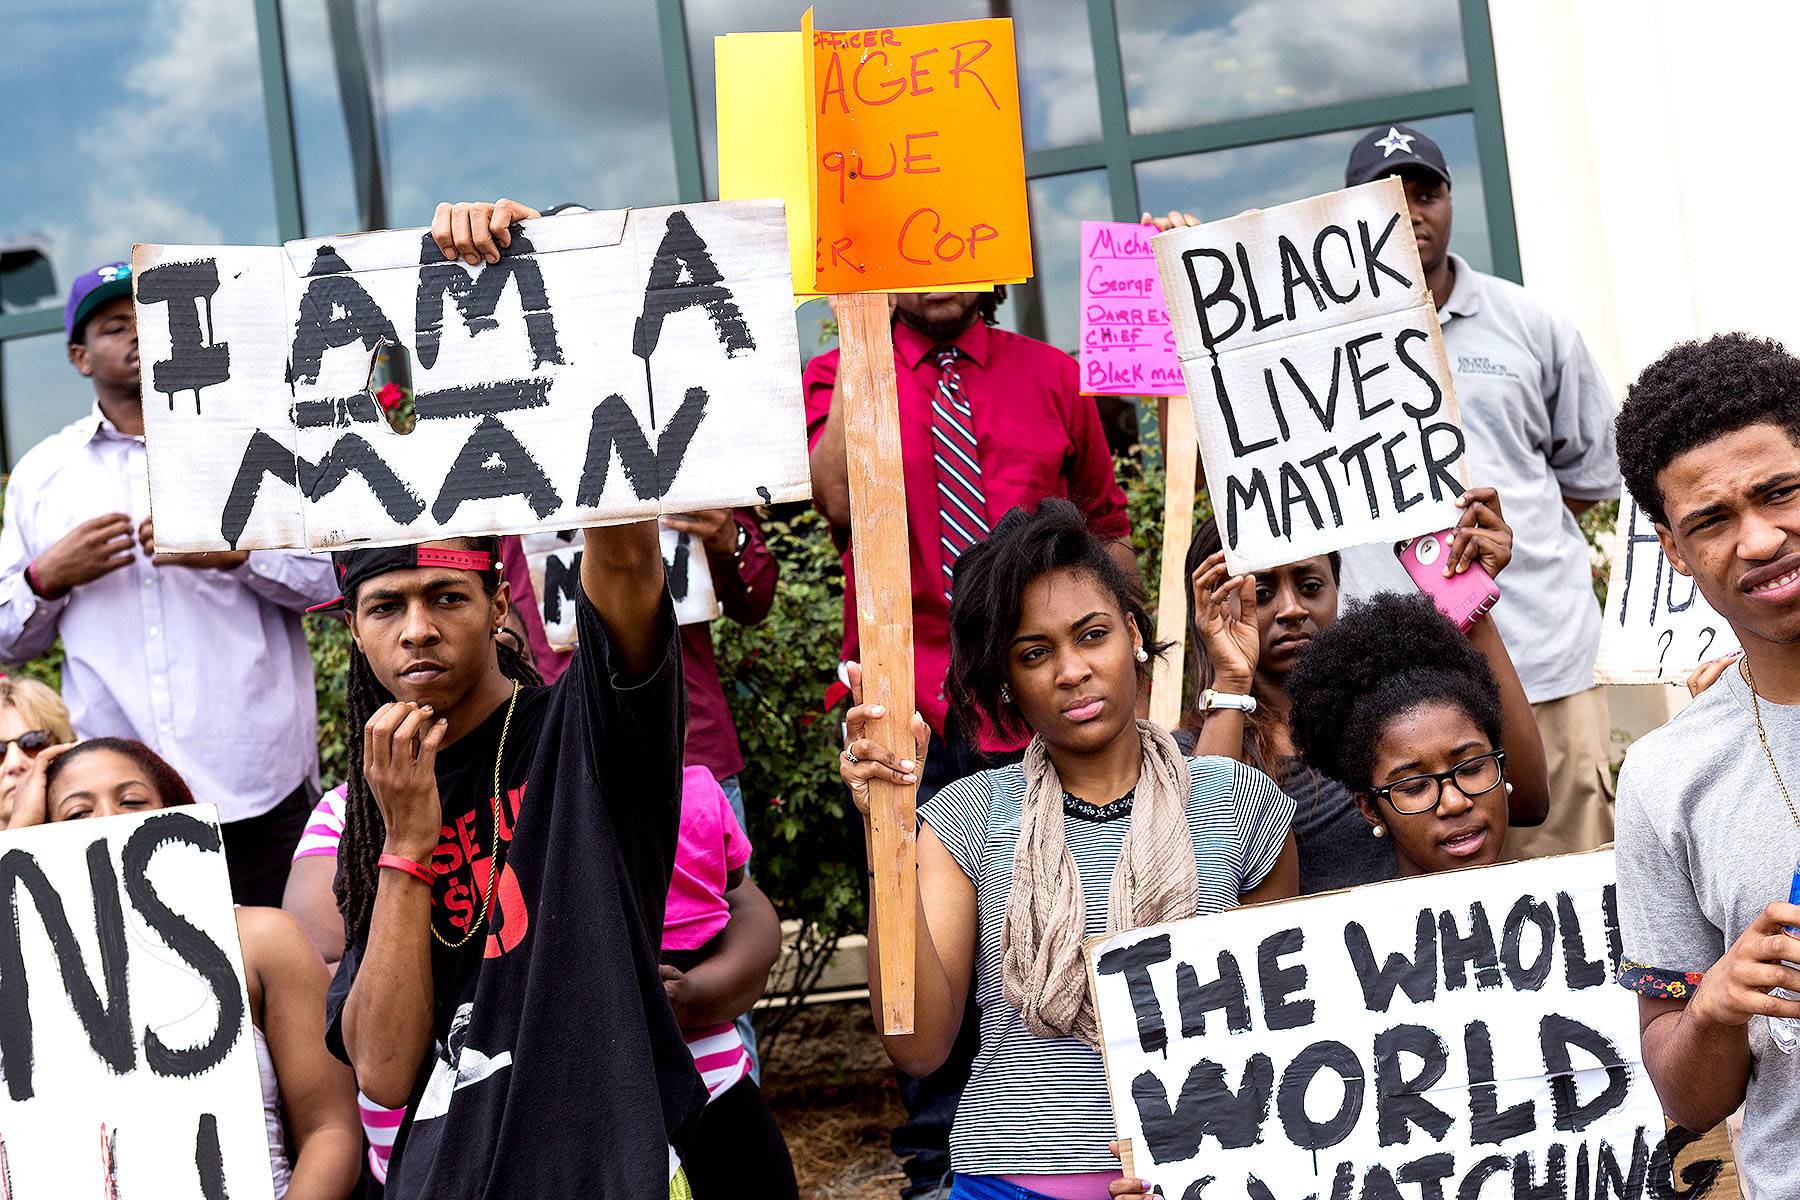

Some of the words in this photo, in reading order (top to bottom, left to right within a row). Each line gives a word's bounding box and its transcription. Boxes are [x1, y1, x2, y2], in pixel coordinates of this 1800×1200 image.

[820, 39, 1000, 114] AGER
[137, 257, 230, 397] I
[285, 224, 567, 385] AM
[632, 210, 757, 362] A
[1182, 211, 1414, 350] BLACK
[1211, 328, 1442, 457] LIVES
[1226, 421, 1467, 551] MATTER
[1097, 927, 1316, 1059] THE
[1132, 1013, 1637, 1167] WORLD
